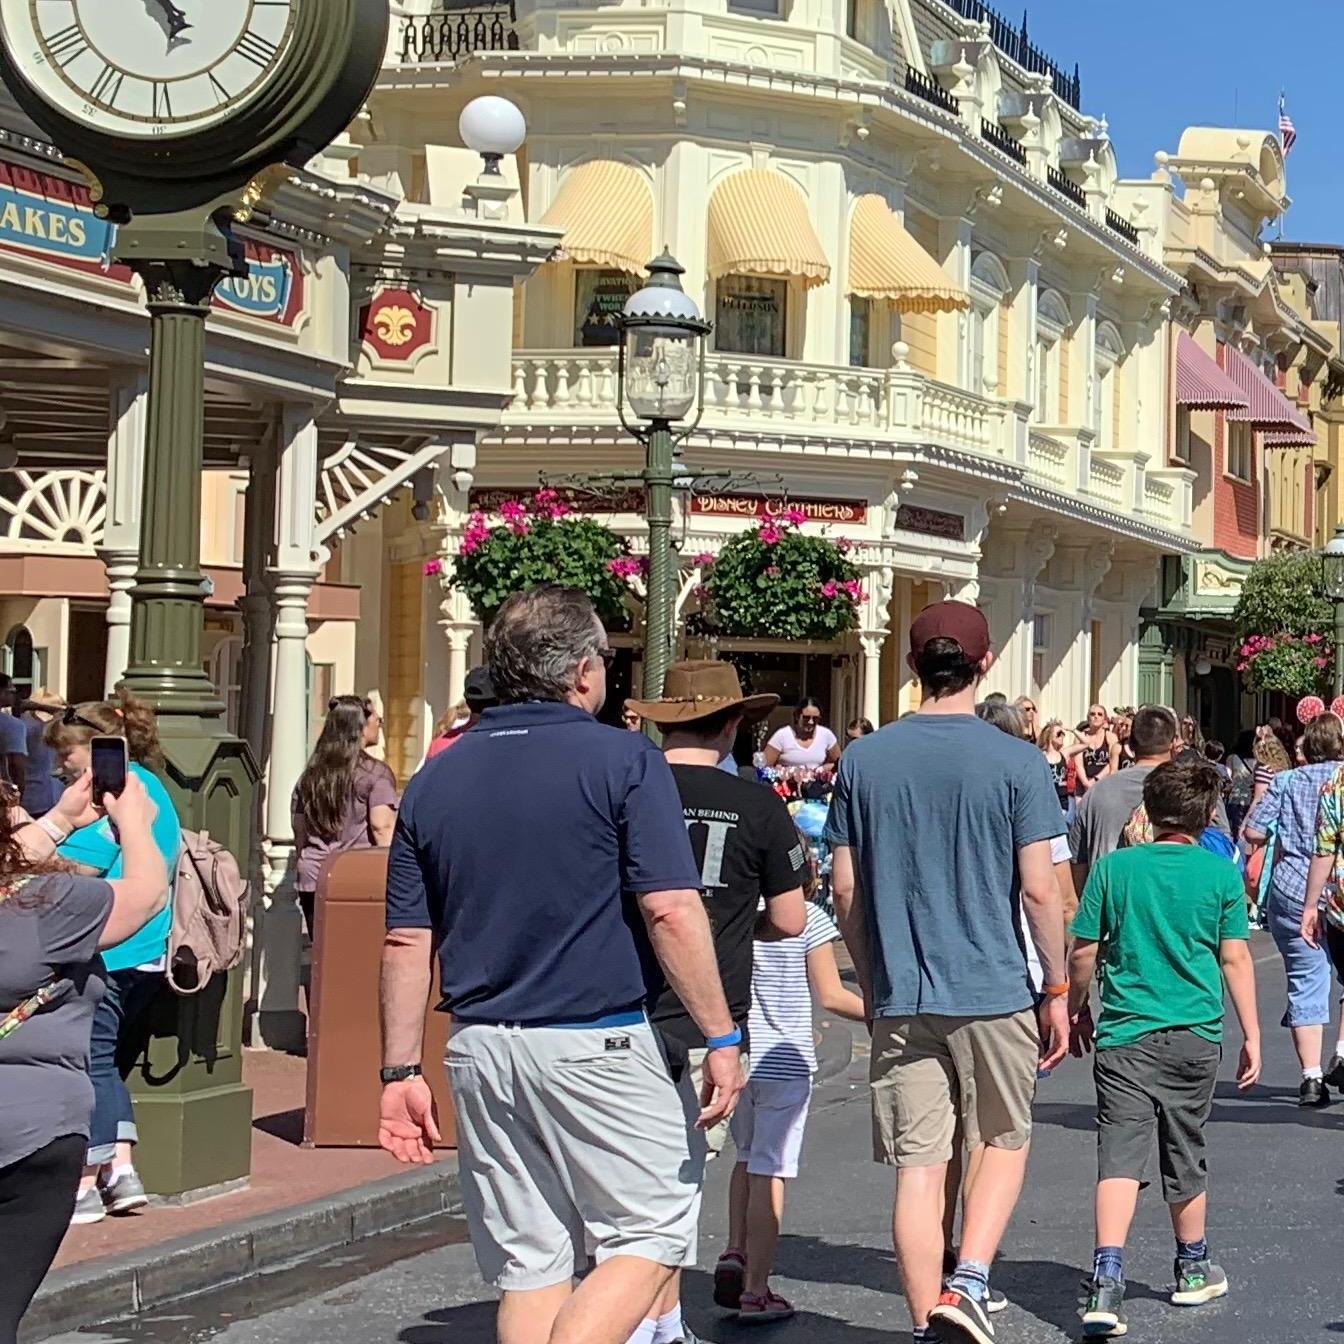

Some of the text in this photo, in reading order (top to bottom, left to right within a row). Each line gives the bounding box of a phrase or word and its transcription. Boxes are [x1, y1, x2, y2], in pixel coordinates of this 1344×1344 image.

[0, 201, 87, 248] AKES
[697, 496, 759, 515] DISNEY
[697, 808, 739, 821] BEHIND
